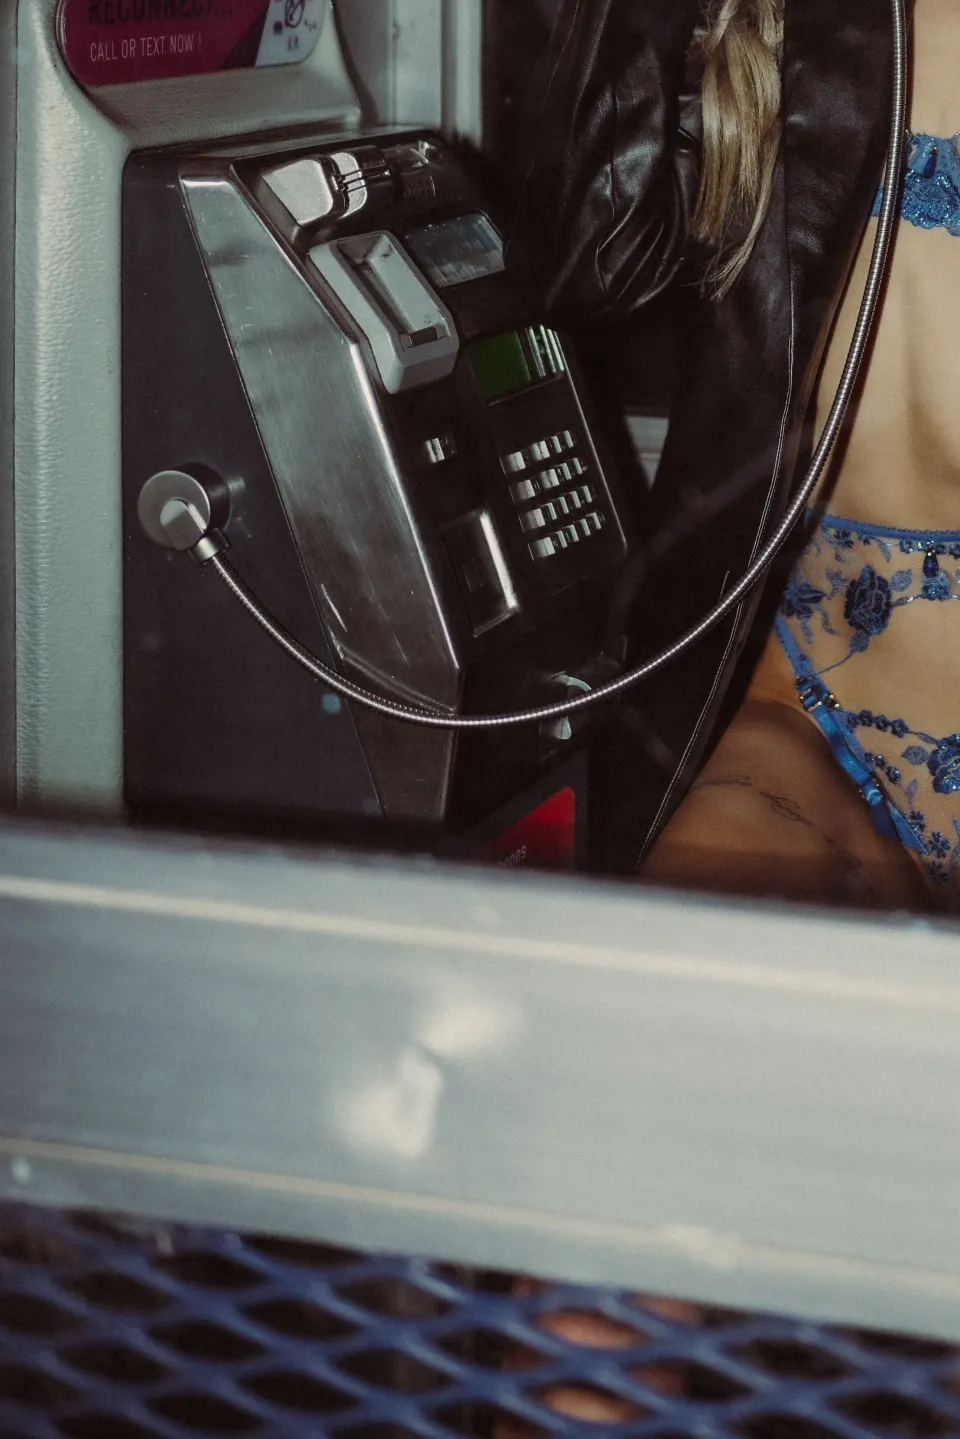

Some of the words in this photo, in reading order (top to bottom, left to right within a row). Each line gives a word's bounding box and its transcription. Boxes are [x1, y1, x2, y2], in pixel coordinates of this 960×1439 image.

[90, 40, 118, 62] CALL
[121, 39, 137, 58] OR
[140, 35, 167, 56] TEXT
[169, 34, 194, 53] NOW
